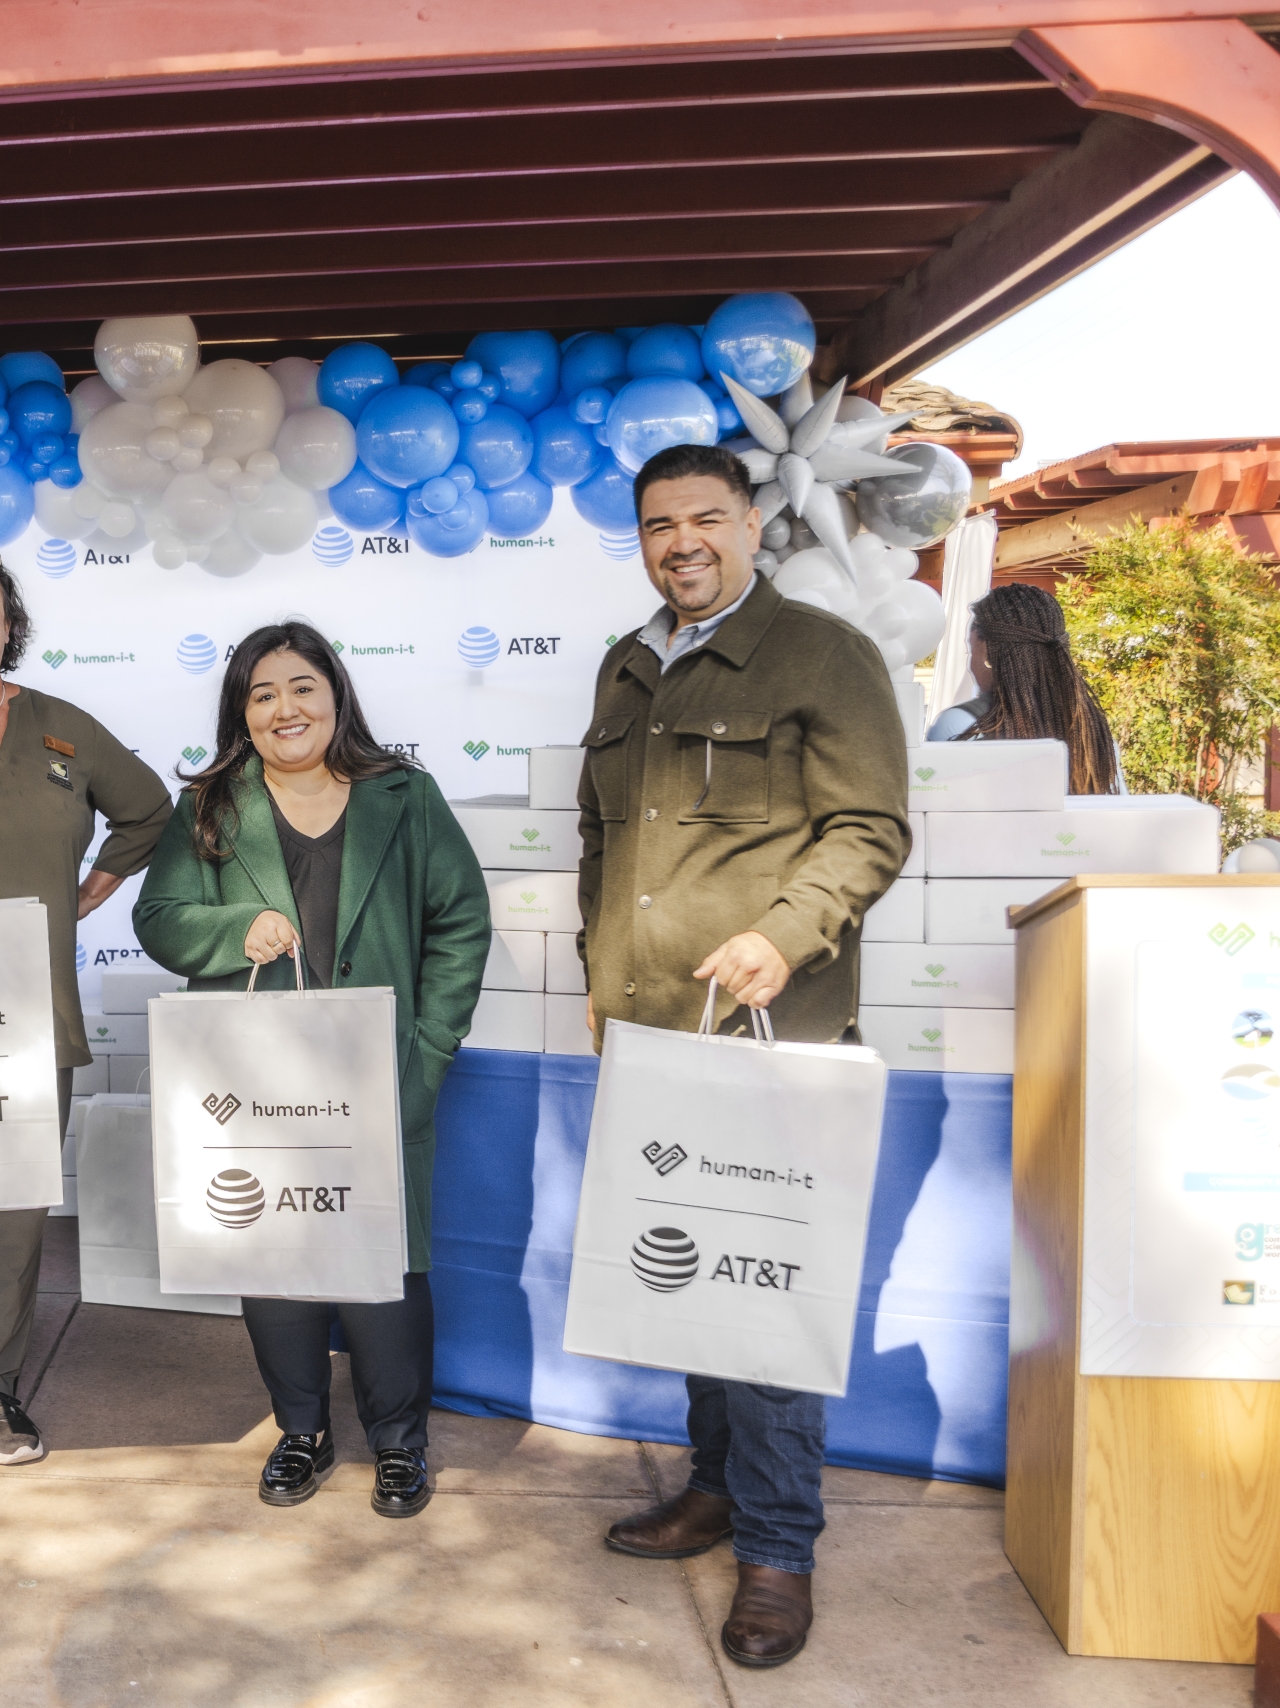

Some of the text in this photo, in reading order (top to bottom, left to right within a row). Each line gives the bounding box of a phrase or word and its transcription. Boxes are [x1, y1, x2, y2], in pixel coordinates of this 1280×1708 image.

[490, 537, 554, 548] human-i-t
[351, 644, 415, 655] human-i-t
[507, 637, 560, 654] AT&T
[74, 652, 135, 664] human-i-t
[908, 784, 949, 792] uman-i-t
[509, 844, 551, 852] human-i-t
[1040, 848, 1090, 856] human-i-t
[508, 906, 549, 914] human-i-t
[911, 980, 959, 988] human-i-t
[908, 1043, 955, 1053] human-i-t
[252, 1100, 351, 1117] human-i-t
[699, 1155, 814, 1190] human-i-t
[275, 1186, 352, 1213] AT&T
[709, 1254, 801, 1291] AT&T
